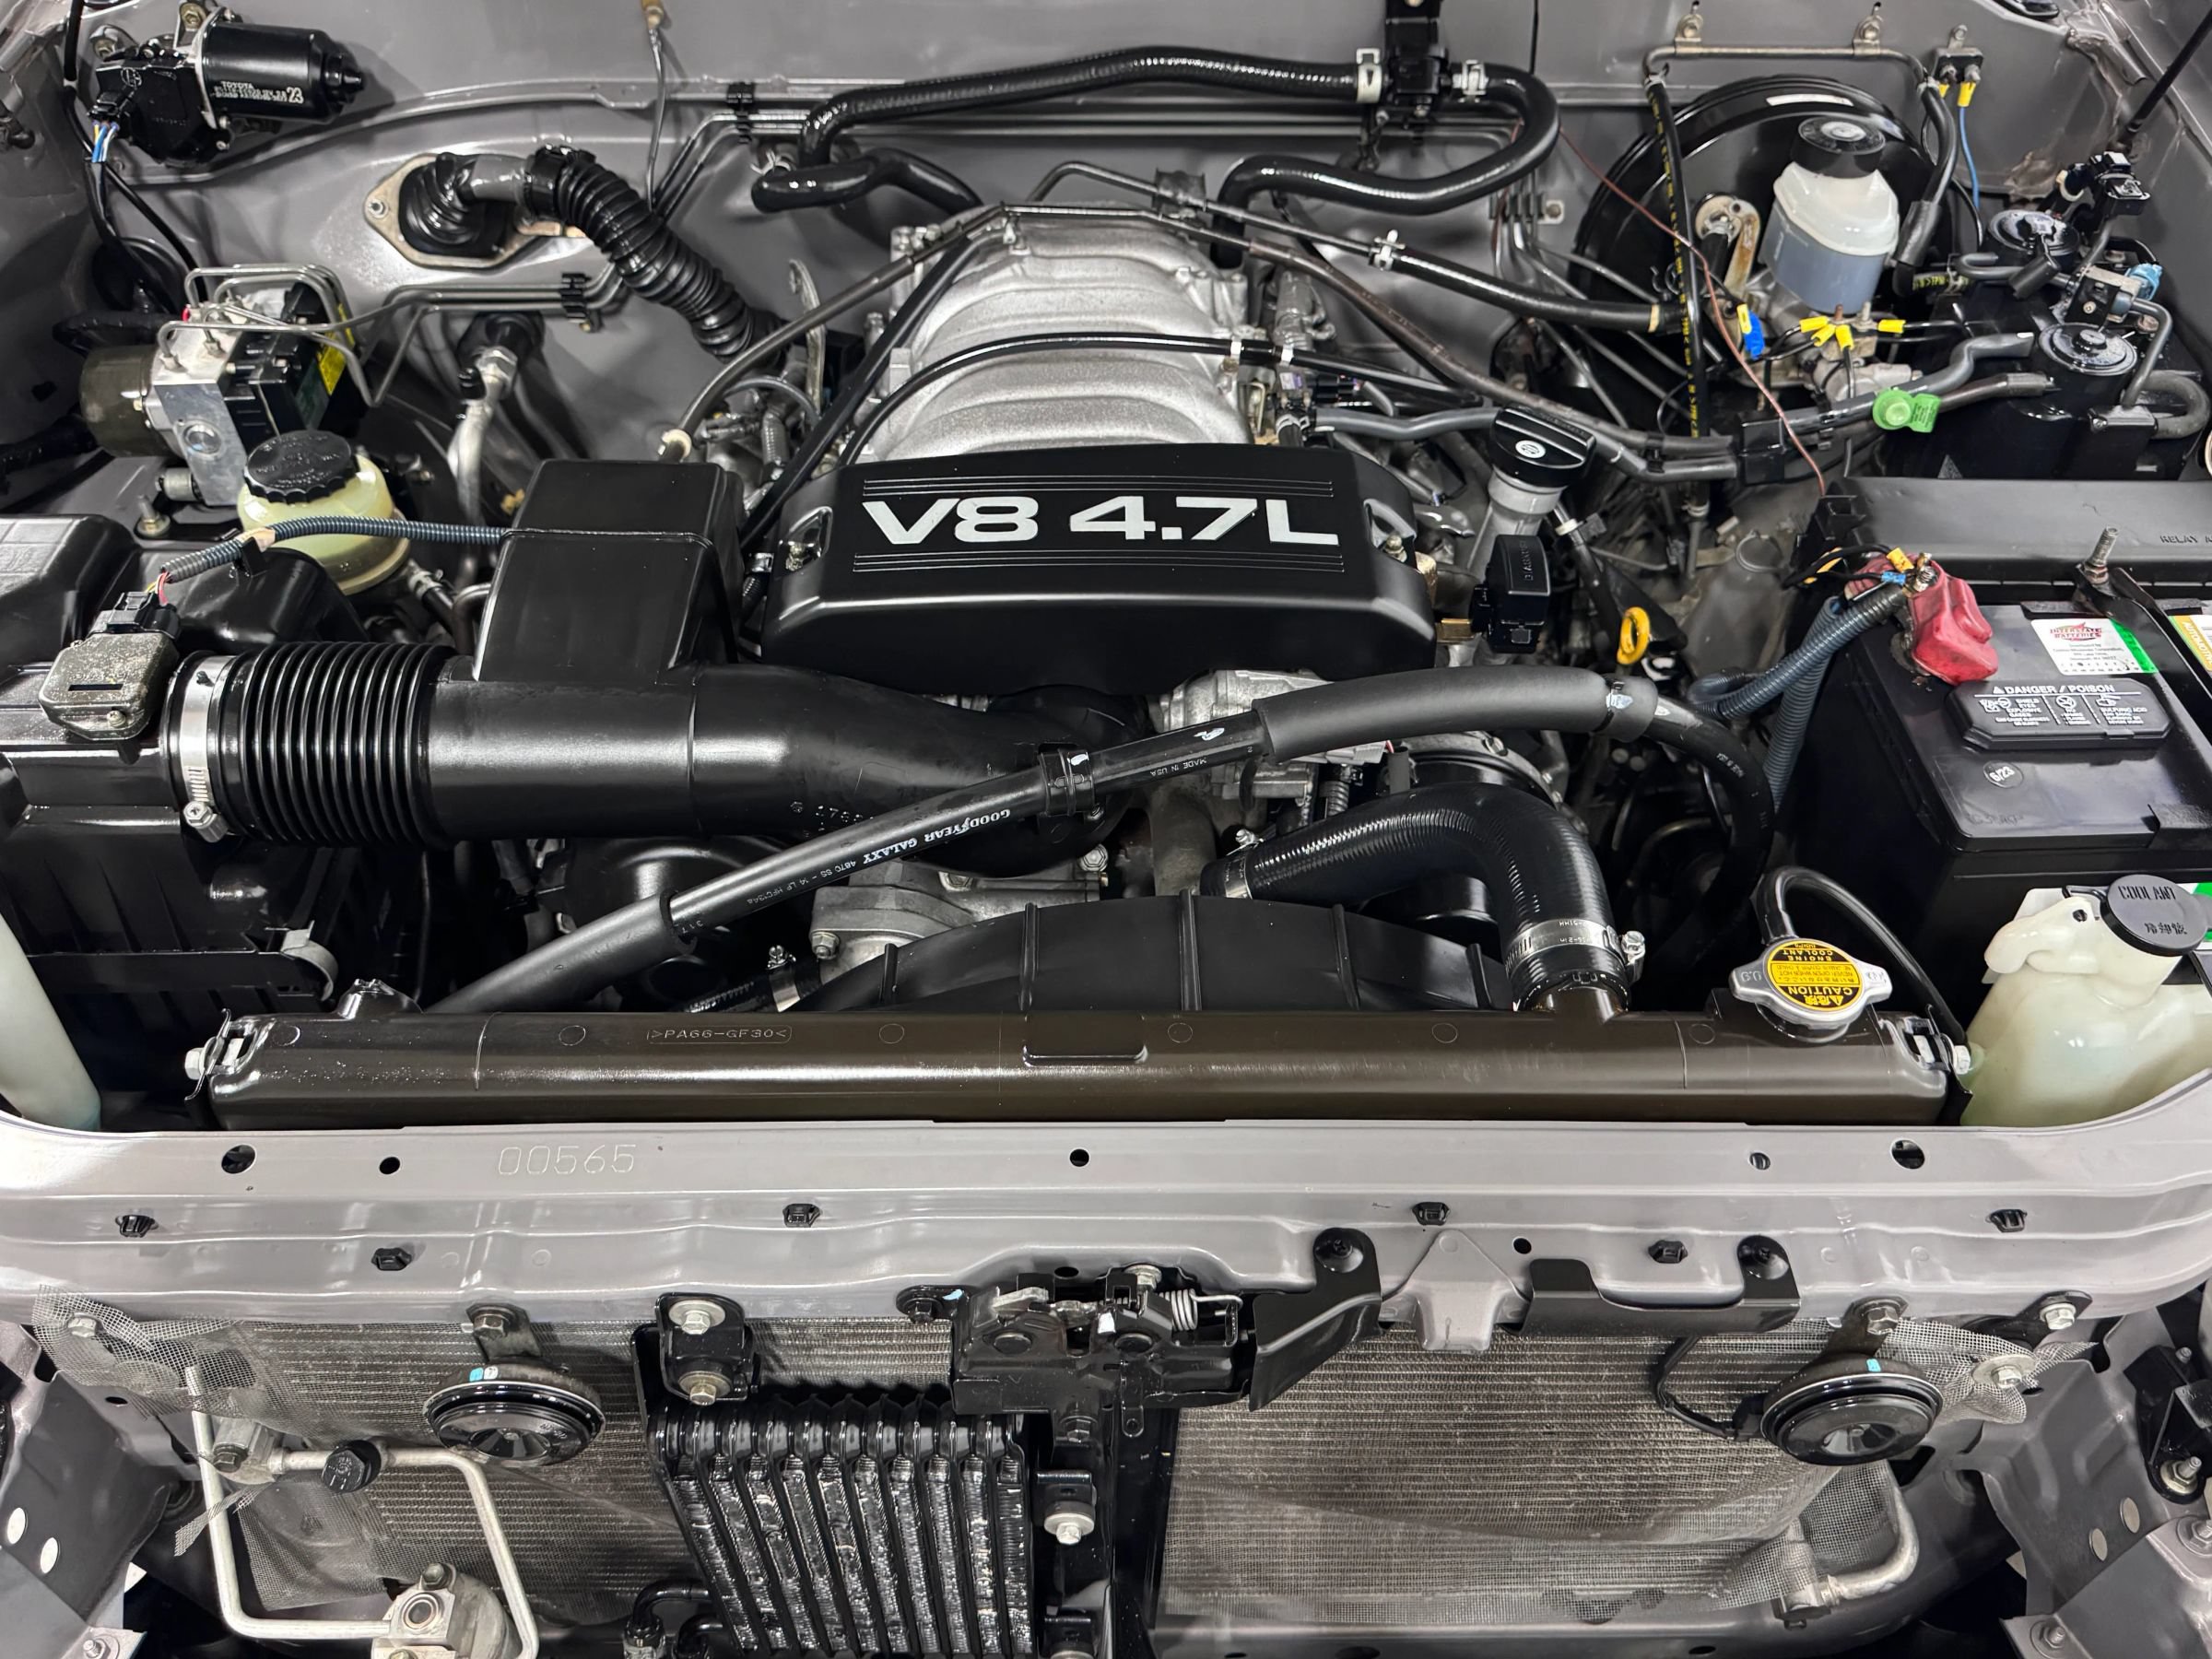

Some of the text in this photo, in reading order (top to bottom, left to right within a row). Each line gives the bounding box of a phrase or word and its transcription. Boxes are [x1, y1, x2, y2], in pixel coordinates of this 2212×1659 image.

[286, 87, 304, 104] 23
[862, 496, 1339, 546] V8 4.7L
[2160, 535, 2198, 544] RELAY
[2004, 685, 2056, 695] DANGER
[2068, 684, 2116, 693] POISON
[1149, 757, 1208, 777] MADE IN USA
[1989, 766, 2016, 782] 6/23
[924, 808, 1012, 843] GOODYEAR
[863, 837, 918, 865] GALAXY
[786, 880, 798, 892] LP
[2117, 886, 2176, 900] COOLANT
[1740, 971, 1762, 983] 0.9
[1788, 985, 1853, 996] CAUTION
[499, 1144, 636, 1175] 00565
